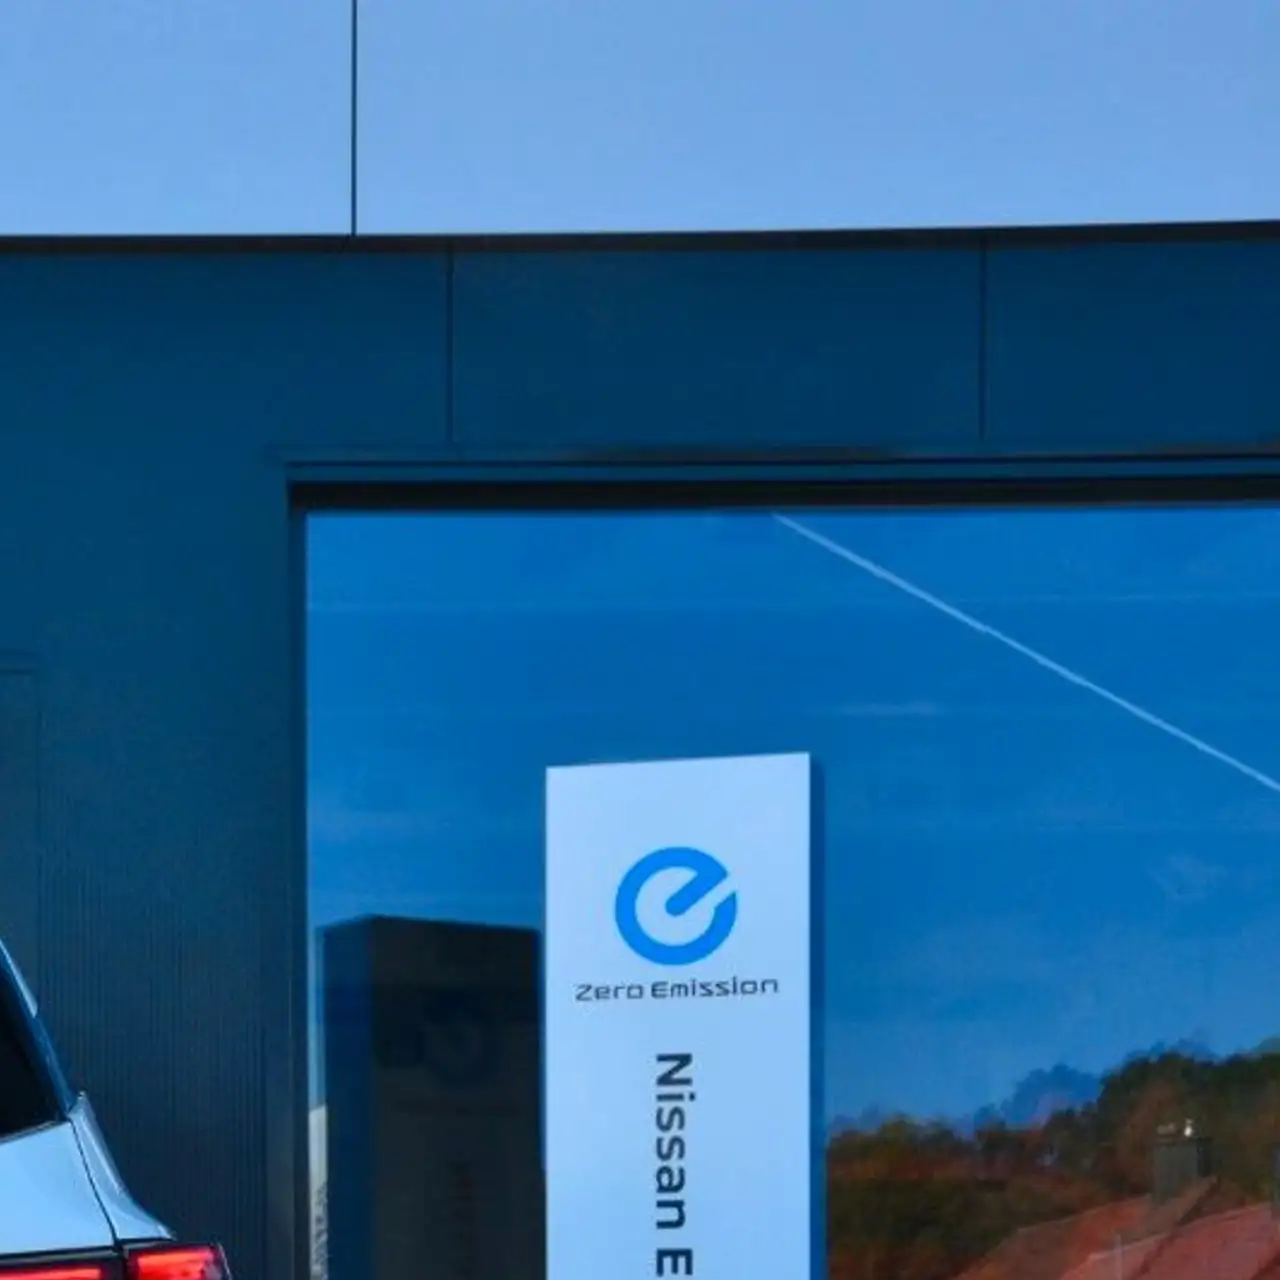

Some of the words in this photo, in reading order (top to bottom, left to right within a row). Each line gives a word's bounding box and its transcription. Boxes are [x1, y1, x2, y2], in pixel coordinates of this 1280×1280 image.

[575, 983, 644, 1001] Zero
[651, 976, 778, 999] Emission
[654, 1052, 697, 1230] Nissan
